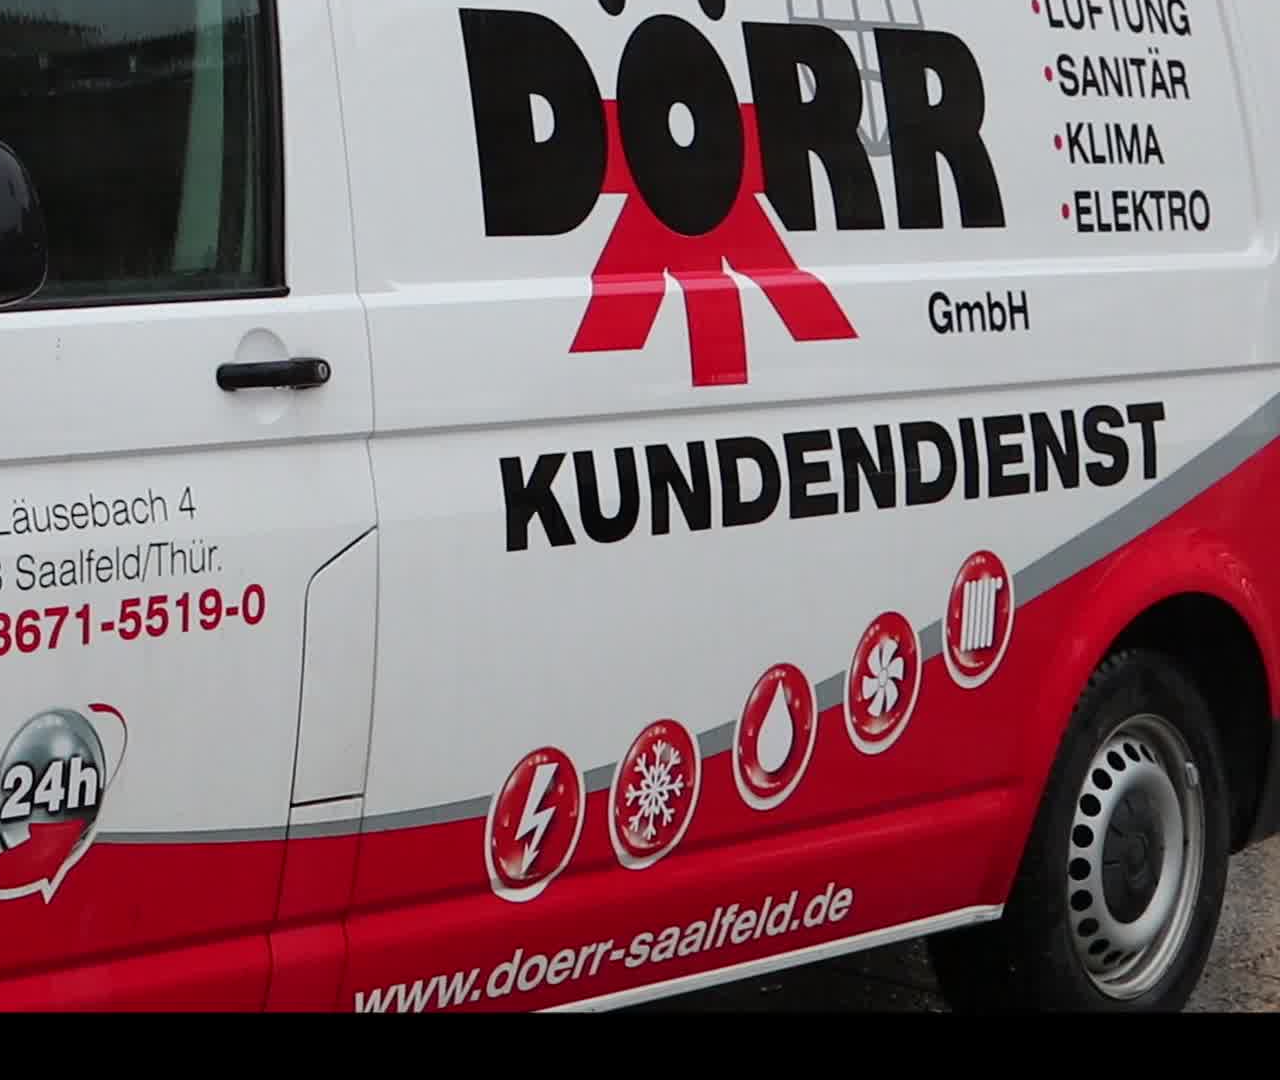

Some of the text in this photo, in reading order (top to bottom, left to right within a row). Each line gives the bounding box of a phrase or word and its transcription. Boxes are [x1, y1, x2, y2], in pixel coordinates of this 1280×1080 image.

[1056, 47, 1190, 100] SANITÄR
[1066, 123, 1164, 166] KLIMA
[1075, 189, 1211, 233] ELEKTRO
[927, 290, 1031, 335] GmbH
[499, 401, 1167, 553] KUNDENDIENST
[178, 486, 197, 520] 4
[15, 541, 222, 592] Saalfeld/Thür.
[0, 755, 98, 821] 24h
[355, 882, 853, 1013] www.doerr-saalfeld.de
